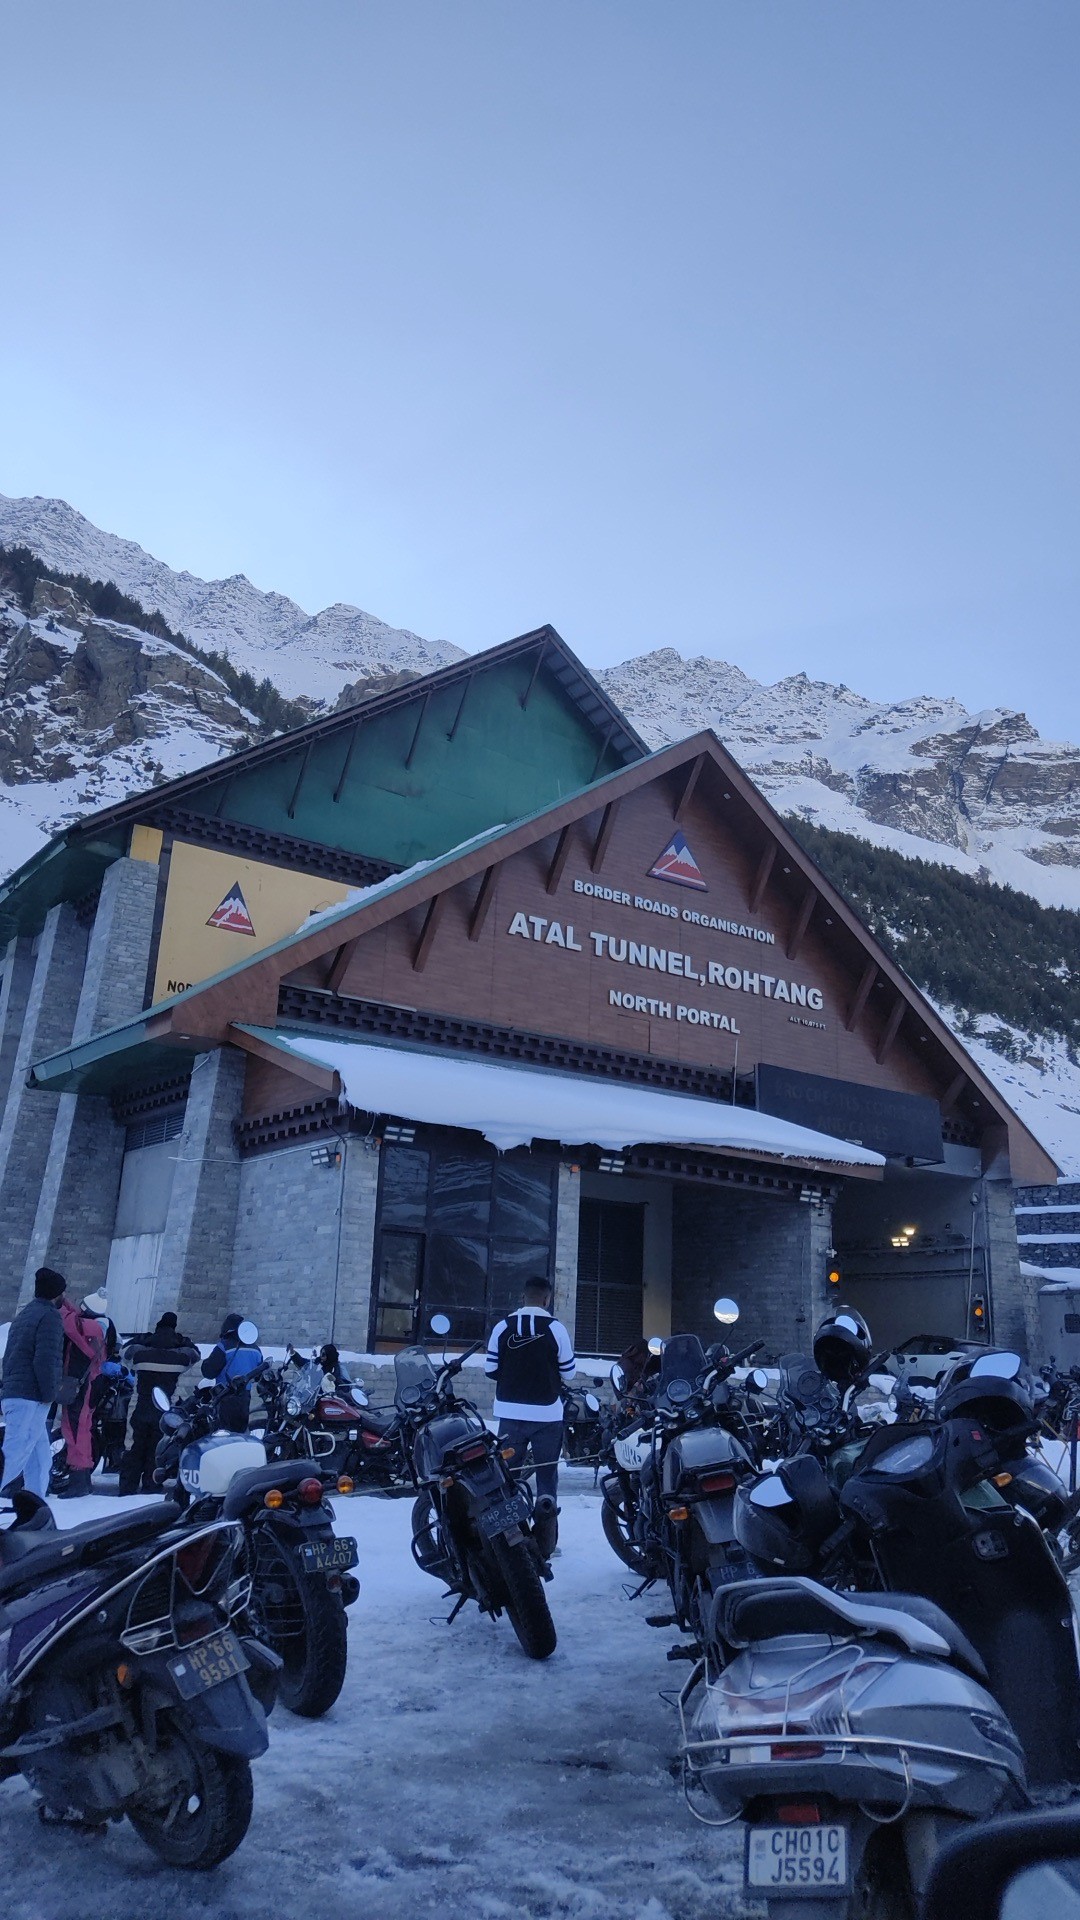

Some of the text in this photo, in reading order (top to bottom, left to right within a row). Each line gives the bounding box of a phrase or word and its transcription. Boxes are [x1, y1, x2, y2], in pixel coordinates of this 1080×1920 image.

[574, 879, 775, 945] BORDER ROADS ORGANISATION
[508, 911, 582, 952] ATAL
[609, 989, 741, 1034] NORTH PORTAL
[312, 1539, 349, 1556] HP 66
[316, 1551, 352, 1569] A4407
[187, 1634, 234, 1670] HP 66
[199, 1653, 240, 1686] 9591
[771, 1856, 839, 1882] J5594
